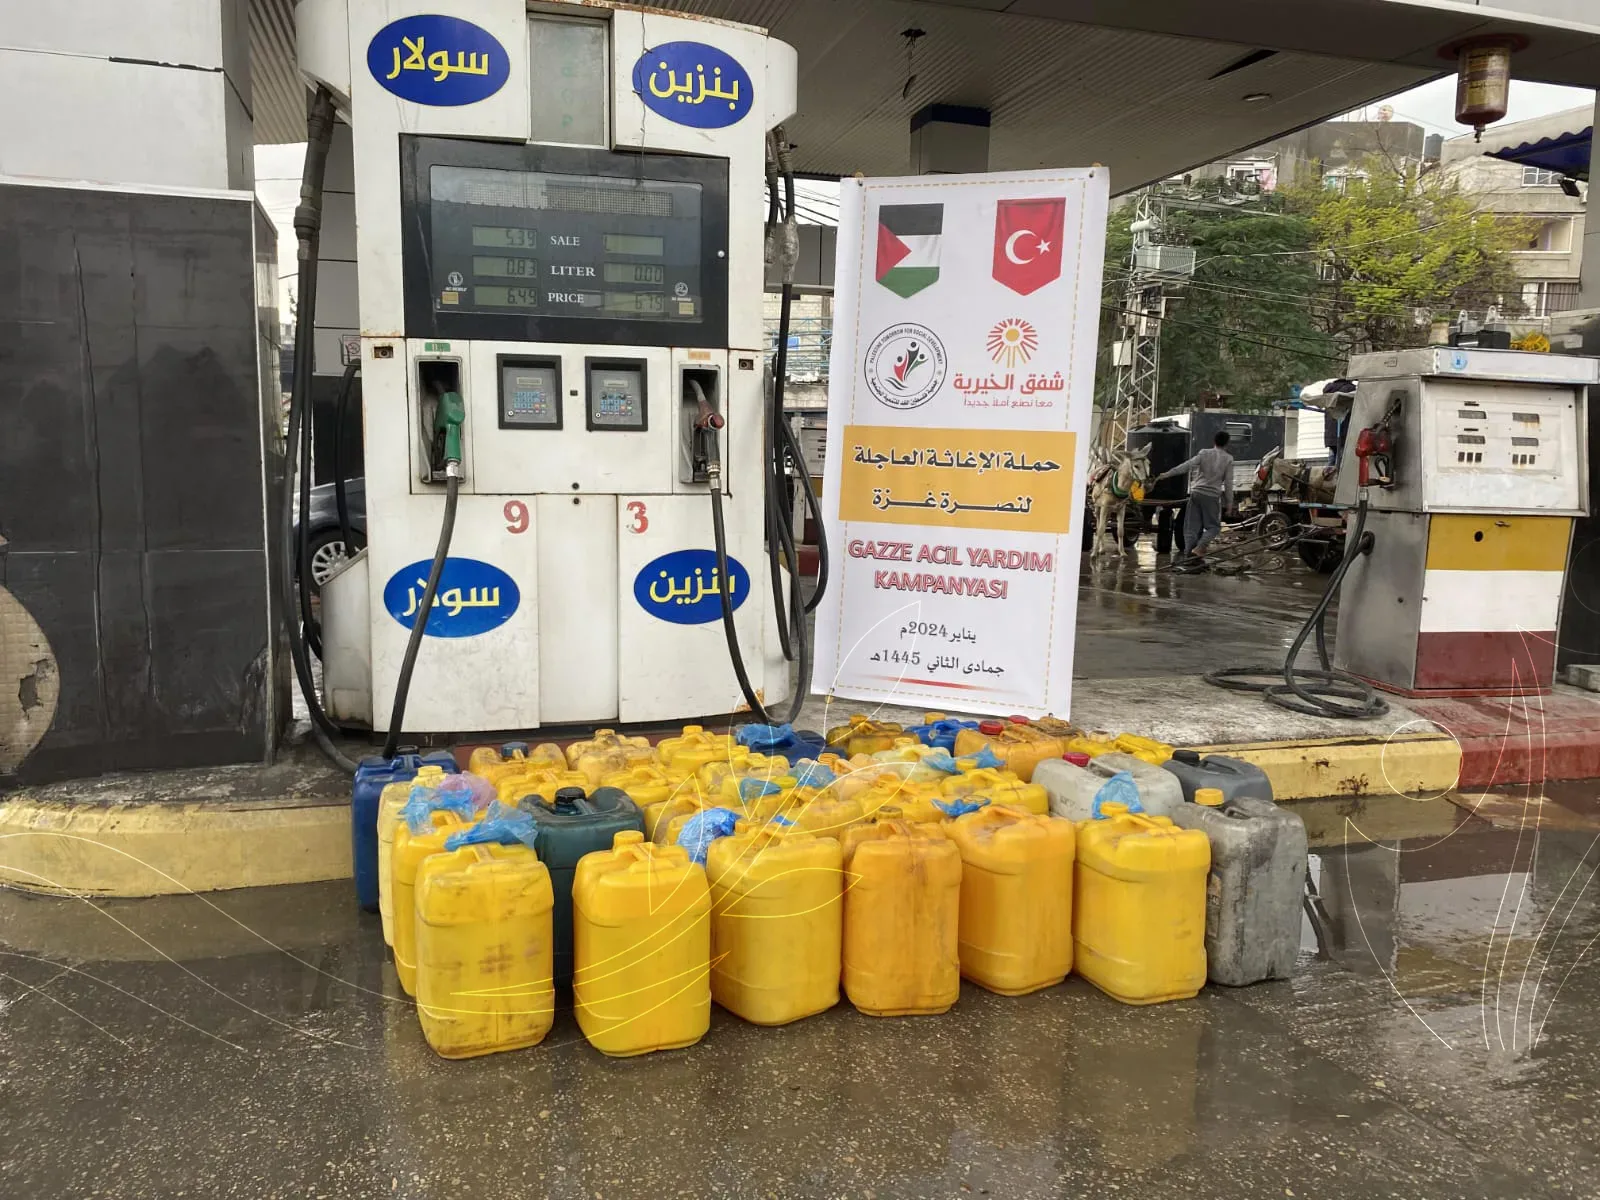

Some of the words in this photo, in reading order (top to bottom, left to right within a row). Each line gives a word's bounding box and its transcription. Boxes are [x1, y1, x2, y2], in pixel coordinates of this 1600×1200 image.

[386, 36, 489, 82] سولار
[649, 61, 740, 111] بنزين
[550, 235, 581, 247] SALE
[551, 265, 596, 278] LITER
[548, 292, 585, 304] PRICE
[953, 373, 1014, 395] الخيرية
[1020, 371, 1064, 395] شفق
[854, 446, 924, 470] العاجلة
[926, 449, 1001, 475] الإغاثة
[1003, 451, 1061, 473] حملة
[872, 488, 937, 510] غزة
[939, 492, 1033, 513] لنصرة
[503, 500, 530, 534] 9
[625, 501, 649, 534] 3
[848, 540, 913, 562] GAZZE
[967, 547, 1053, 572] YARDIM
[874, 570, 1009, 599] KAMPANYASI
[948, 627, 977, 644] يناير
[926, 655, 959, 673] الثاني
[962, 660, 1005, 677] جمادى
